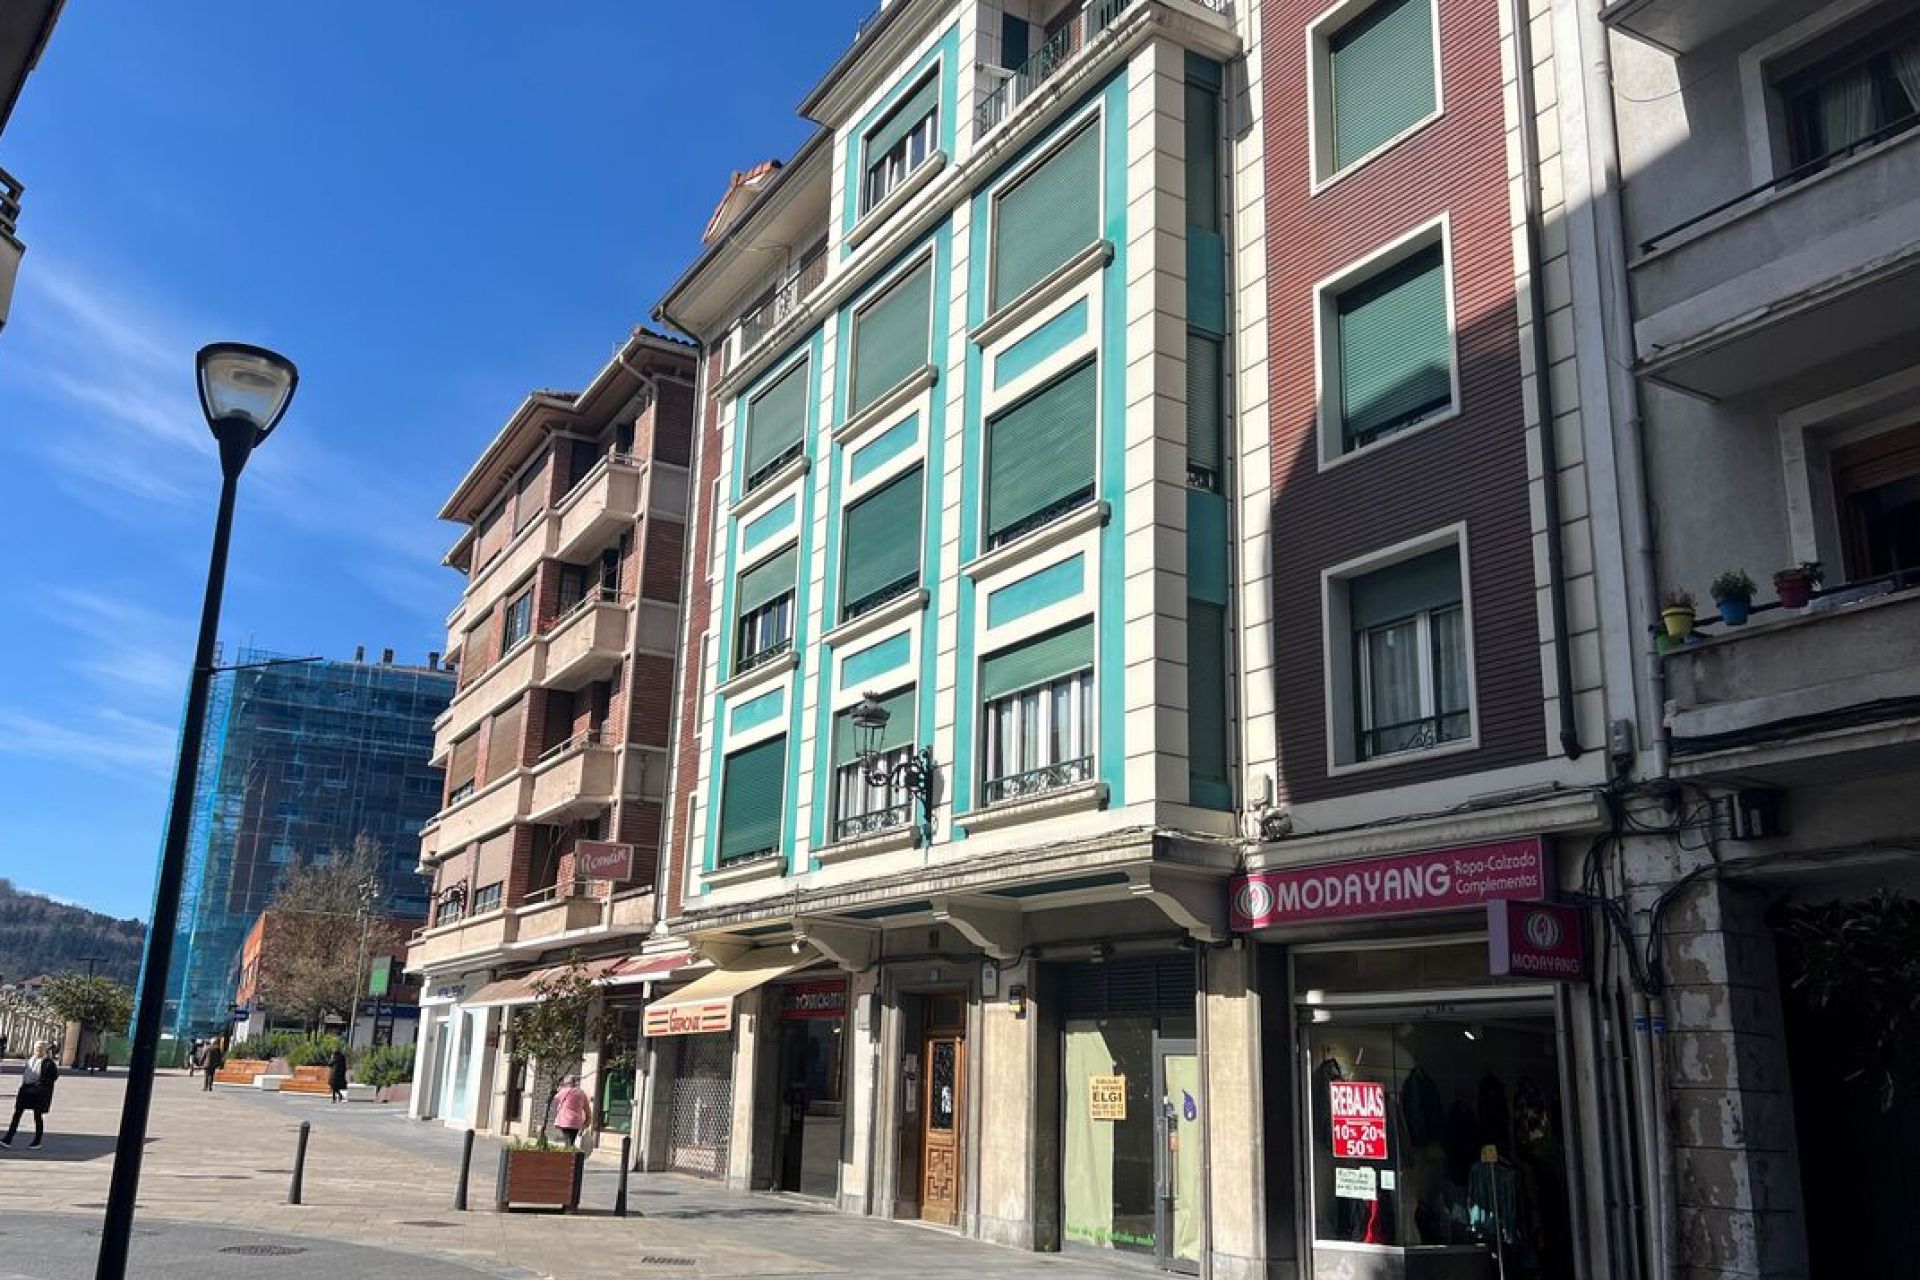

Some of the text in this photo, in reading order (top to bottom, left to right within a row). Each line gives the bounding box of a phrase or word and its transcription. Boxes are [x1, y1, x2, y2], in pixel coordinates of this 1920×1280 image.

[1455, 852, 1536, 876] Ropa-Calzado
[1277, 862, 1450, 913] MODAYANG
[1455, 874, 1538, 897] Complementos
[1511, 953, 1580, 973] MODAYANG
[1092, 1092, 1122, 1102] ELGI
[1331, 1085, 1385, 1117] REBAJAS
[1334, 1124, 1385, 1141] 10% 20%
[1347, 1140, 1374, 1155] 50%
